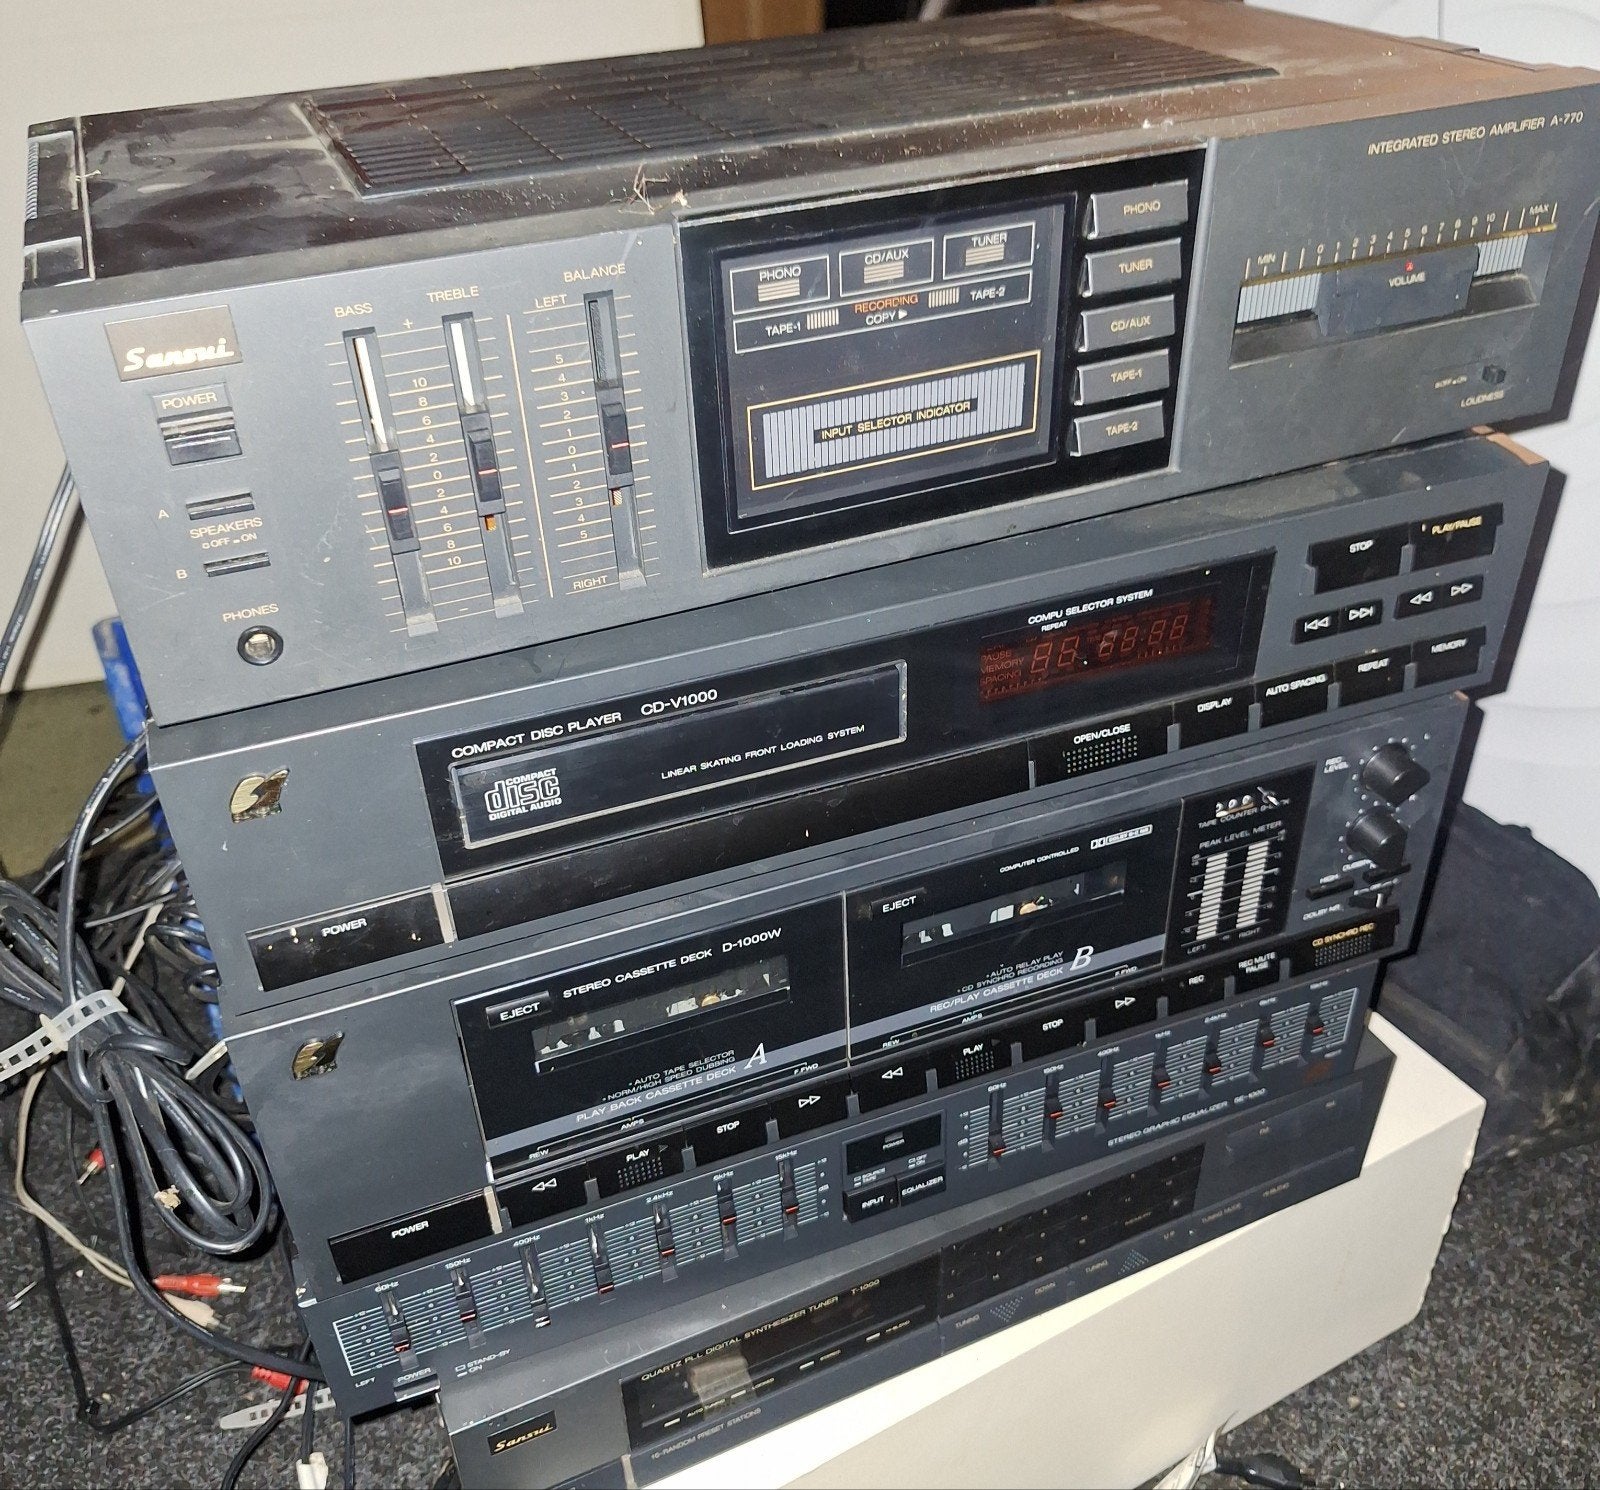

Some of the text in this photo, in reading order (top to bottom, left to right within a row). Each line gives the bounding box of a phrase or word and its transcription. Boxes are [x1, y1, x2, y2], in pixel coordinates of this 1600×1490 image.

[1368, 111, 1584, 155] INTEGRATED STEREO AMPLIFIER A-770
[1123, 199, 1161, 215] PHONO
[1530, 204, 1550, 215] MAX
[972, 232, 1007, 247] TUNER
[864, 249, 909, 266] CD/AUX
[1118, 258, 1152, 273] TUNER
[1258, 254, 1276, 264] MIN
[564, 264, 626, 282] BALANCE
[759, 266, 801, 282] PHONO
[1389, 272, 1426, 287] VOLUME
[427, 286, 480, 303] TREBLE
[535, 294, 567, 309] LEFT
[970, 286, 1005, 301] TAPE-2
[334, 302, 373, 318] BASS
[854, 294, 918, 313] RECORDING
[866, 309, 896, 326] COPY
[1110, 315, 1151, 332] CD/AUX
[766, 322, 801, 337] TAPE-1
[124, 338, 234, 372] Sansui
[413, 377, 427, 387] 10
[1110, 367, 1142, 383] TAPE-1
[162, 392, 218, 409] POWER
[821, 401, 970, 440] INPUT SELECTOR INDICATOR
[1106, 421, 1138, 436] TAPE-2
[158, 509, 169, 518] A
[190, 517, 263, 539] SPEAKERS
[210, 532, 257, 548] OFF ON
[1350, 539, 1373, 553] STOP
[448, 556, 462, 566] 10
[177, 569, 187, 579] B
[573, 575, 608, 590] RIGHT
[222, 603, 279, 622] PHONES
[1028, 589, 1153, 624] COMPU SELECTOR SYSTEM
[1042, 620, 1068, 632] REPEAT
[1358, 658, 1390, 673] REPEAT
[1266, 674, 1326, 697] AUTO SPACING
[1197, 697, 1232, 713] DISPLAY
[451, 689, 718, 759] COMPACT DISC PLAYER CD-V1000
[1074, 724, 1130, 744] OPEN/CLOSE
[661, 724, 865, 780] LINEAR SKATING FRONT LOADING SYSTEM
[505, 768, 556, 786] COMPACT
[488, 797, 562, 822] DIGITAL AUDIO
[1200, 820, 1282, 849] PEAK LEVEL METER
[1000, 846, 1080, 873] COMPUTER CONTROLLED
[882, 896, 916, 912] EJECT
[322, 918, 368, 938] POWER
[1187, 944, 1206, 954] LEFT
[563, 928, 782, 998] STEREO CASSETTE DECK D-1000W
[991, 951, 1064, 977] AUTO RELAY PLAY
[1254, 952, 1276, 964] MUTE
[962, 958, 1064, 993] CD SYNCHRO RECORDING
[1246, 962, 1269, 973] PAUSE
[930, 945, 1094, 1013] REC/PLAY CASSETTE DECK B
[1189, 975, 1204, 986] REC
[500, 1002, 540, 1021] EJECT
[962, 1013, 982, 1024] AMPS
[1043, 1019, 1063, 1031] STOP
[882, 1038, 900, 1048] REW
[963, 1044, 984, 1056] PLAY
[635, 1050, 734, 1086] AUTO TAPE SELECTOR
[576, 1043, 767, 1122] PLAY BACK CASSETTE DECK A
[608, 1057, 736, 1101] NORM/HIGH SPEED DUBBING
[620, 1118, 644, 1130] AMPS
[716, 1121, 740, 1134] STOP
[528, 1148, 549, 1160] REW
[626, 1149, 649, 1162] PLAY
[775, 1150, 798, 1161] 15kHz
[902, 1176, 944, 1196] EQUALIZER
[862, 1196, 884, 1208] INPUT
[585, 1213, 605, 1224] 1kHz
[392, 1221, 429, 1238] POWER
[513, 1234, 541, 1247] 400Hz
[445, 1258, 472, 1269] 150Hz
[374, 1281, 400, 1292] 60Hz
[642, 1279, 880, 1381] QUARTZ PLL DIGITAL SYNTHESIZER TUNER T-1000
[467, 1349, 511, 1368] STAND-BY
[398, 1368, 432, 1383] POWER
[468, 1365, 483, 1374] ON
[355, 1377, 376, 1388] LEFT
[494, 1423, 553, 1452] Sansui
